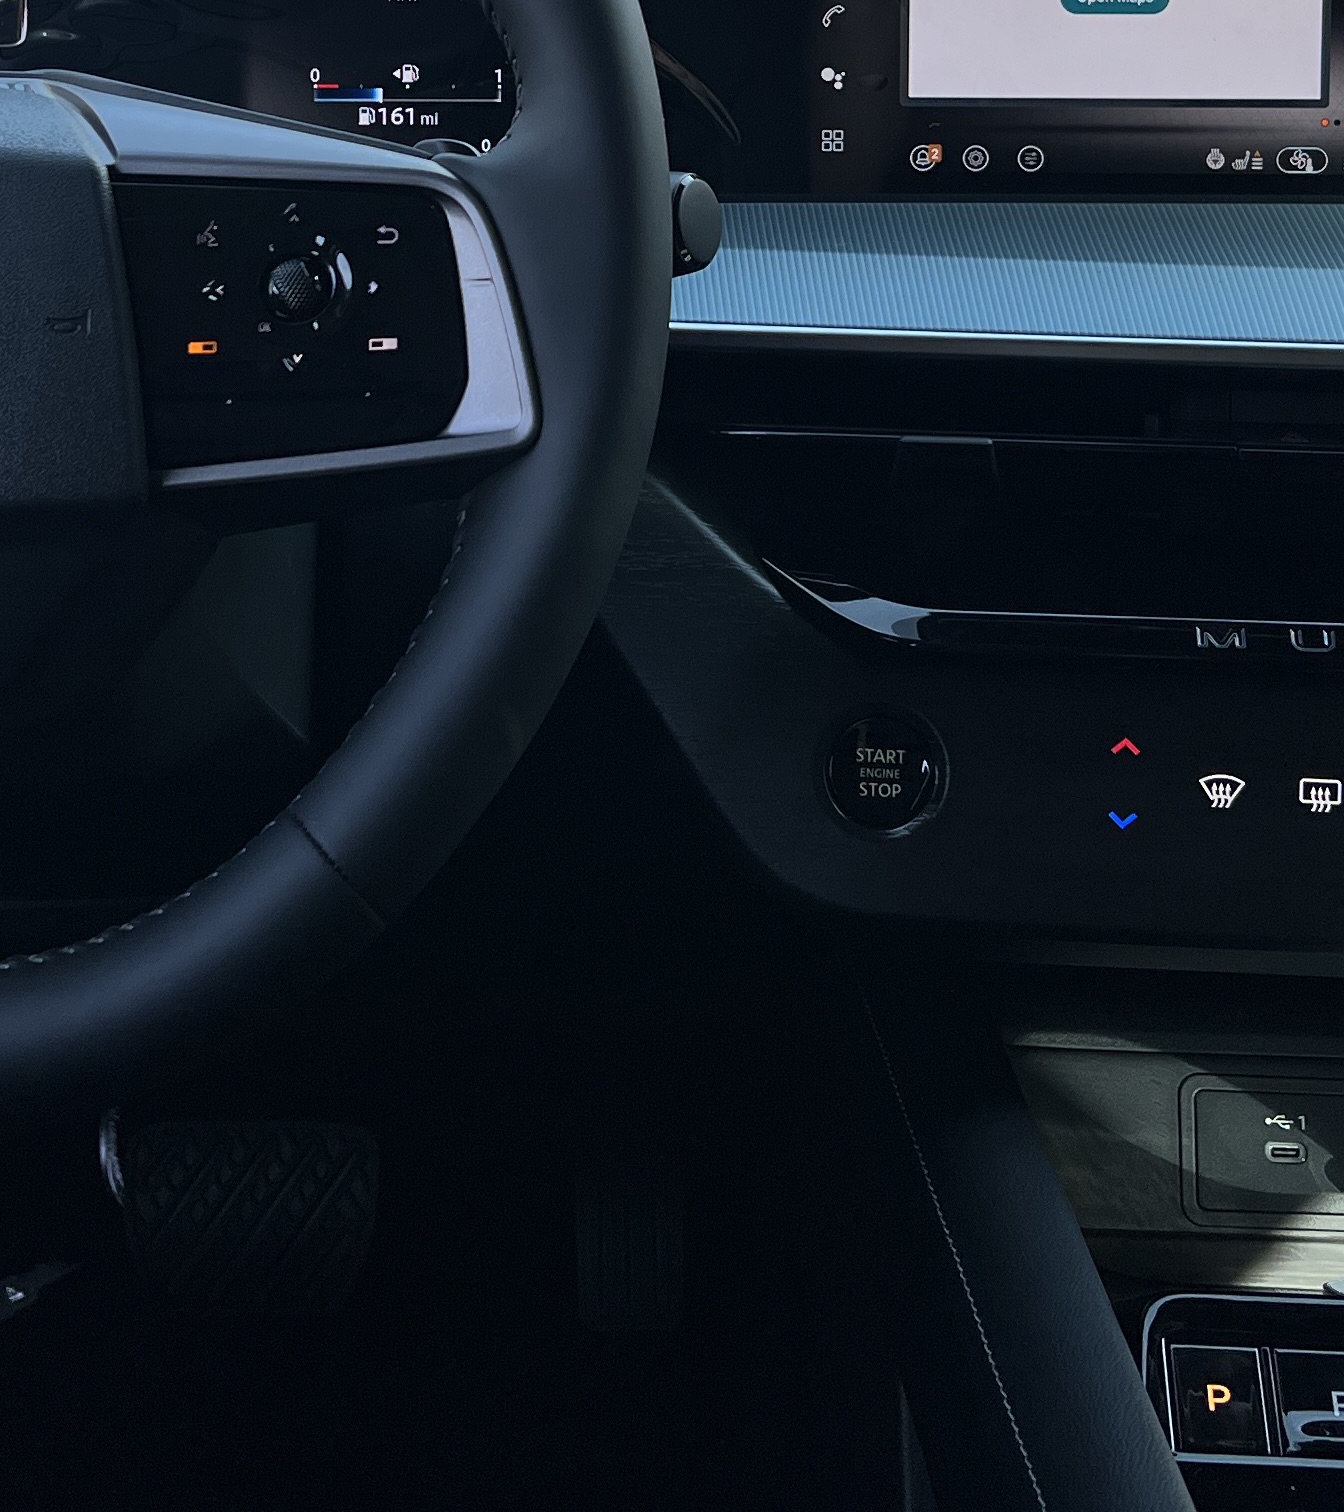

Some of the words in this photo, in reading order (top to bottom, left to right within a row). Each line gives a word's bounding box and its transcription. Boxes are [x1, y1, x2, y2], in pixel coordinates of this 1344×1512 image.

[309, 67, 321, 83] 0
[494, 68, 502, 83] 1
[377, 106, 414, 126] 161
[420, 111, 439, 126] mi
[931, 147, 939, 160] 2
[855, 747, 907, 765] START
[859, 767, 901, 779] ENGINE
[858, 781, 902, 798] STOP
[1297, 1115, 1306, 1131] 1
[1206, 1384, 1231, 1412] P
